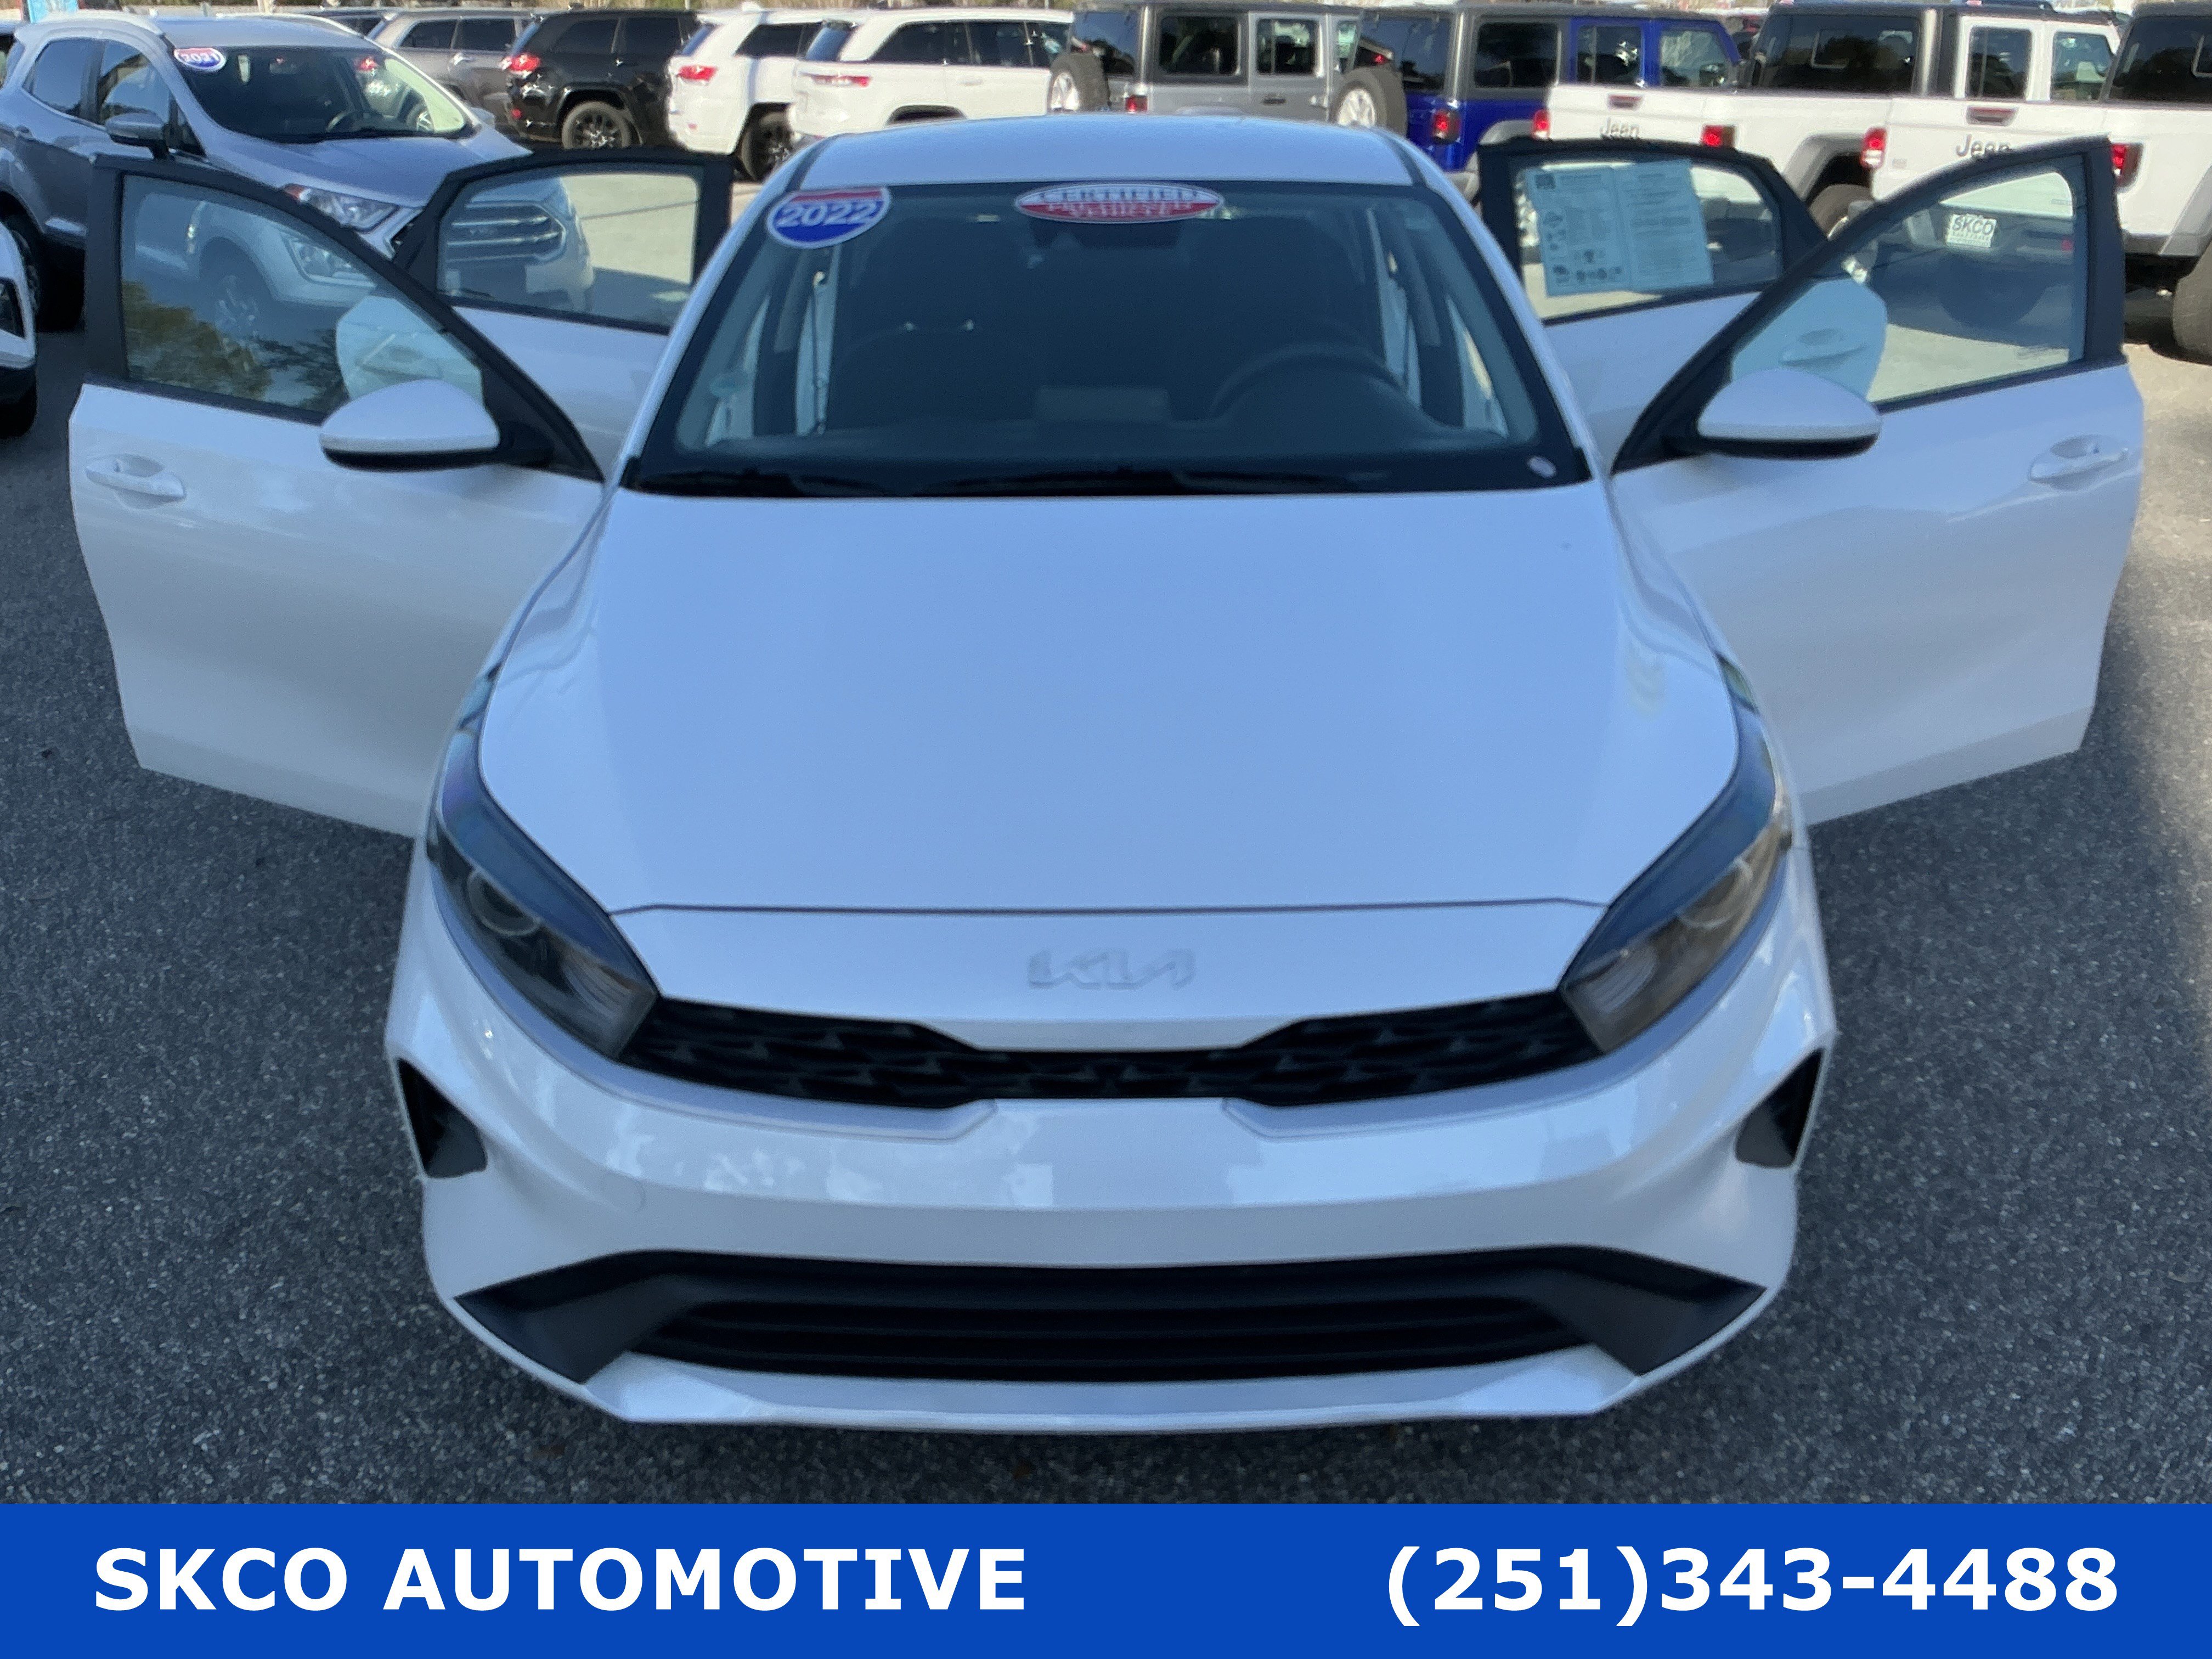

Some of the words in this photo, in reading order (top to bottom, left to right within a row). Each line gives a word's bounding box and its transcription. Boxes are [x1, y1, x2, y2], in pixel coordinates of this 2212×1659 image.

[180, 52, 220, 63] 2021
[776, 200, 878, 227] 2022
[1951, 215, 1994, 236] SKCO
